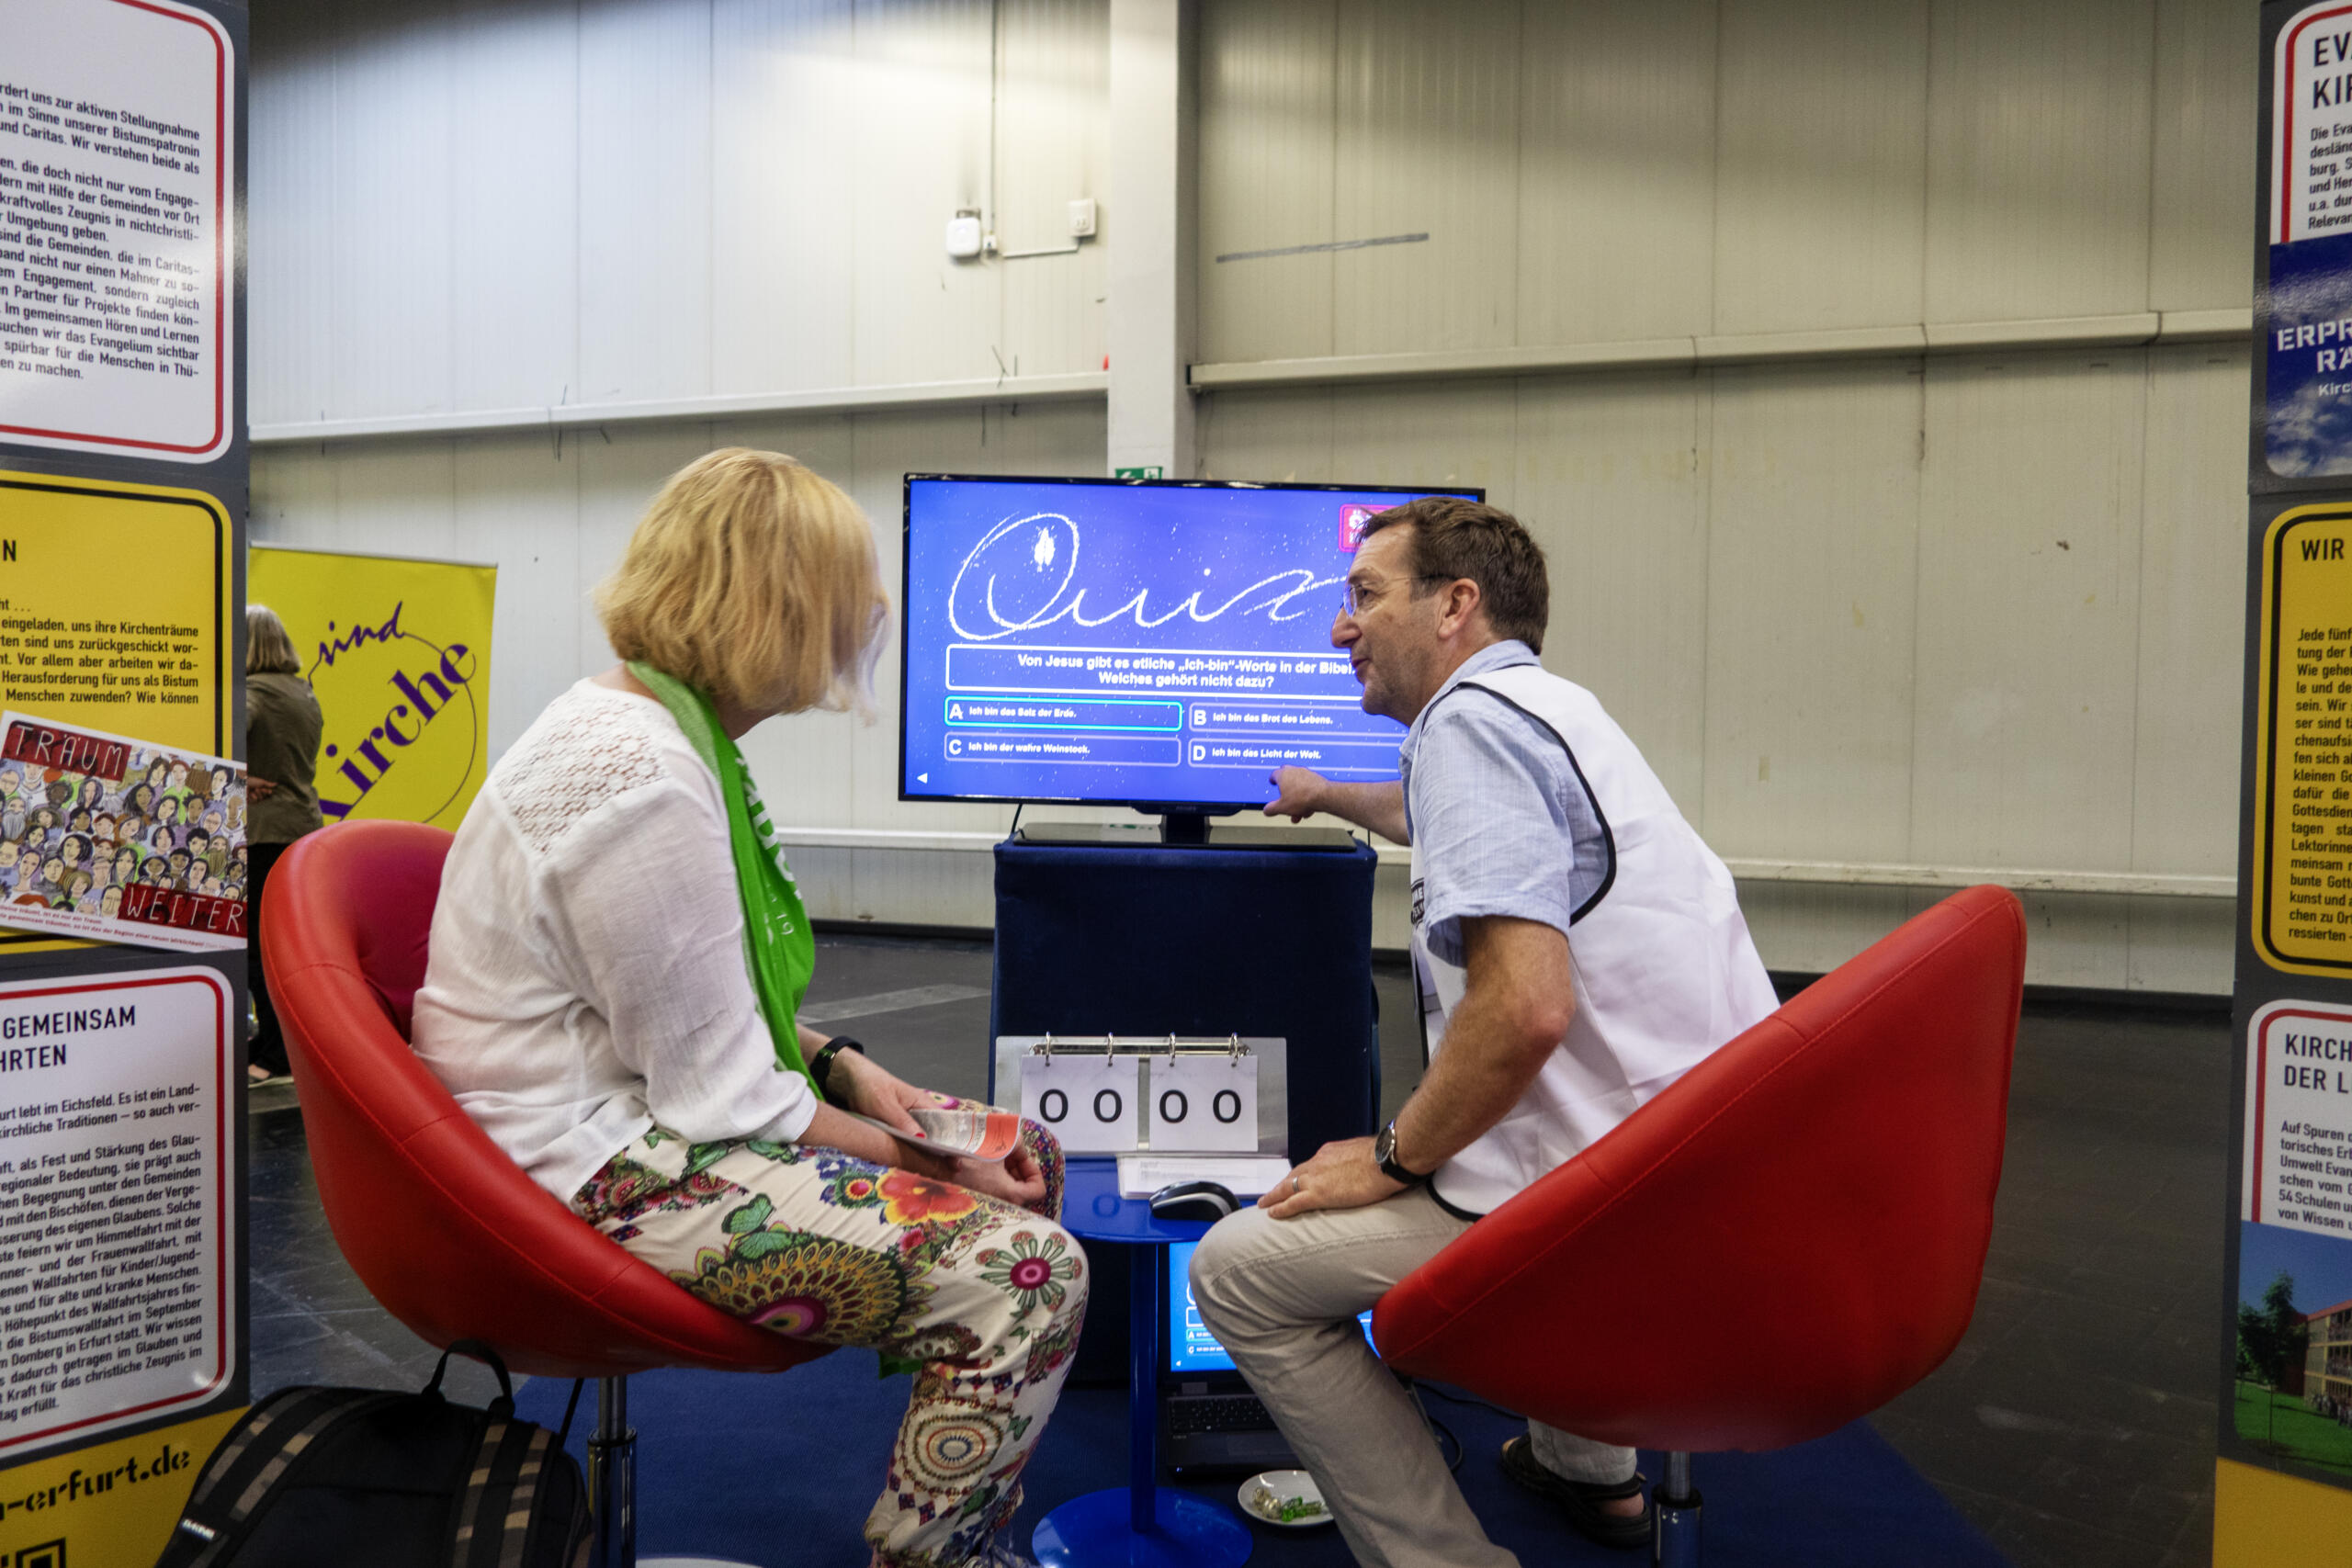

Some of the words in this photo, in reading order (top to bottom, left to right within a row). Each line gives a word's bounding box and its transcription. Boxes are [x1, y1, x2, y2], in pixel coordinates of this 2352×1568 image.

[2314, 31, 2352, 67] EV
[31, 92, 51, 105] uns
[55, 97, 73, 109] zur
[76, 101, 117, 120] aktiven
[120, 110, 199, 140] Stellungnahme
[8, 105, 22, 116] im
[28, 106, 59, 124] Sinne
[64, 118, 107, 135] unserer
[113, 126, 199, 157] Bistumspatronin
[2311, 128, 2328, 141] Die
[71, 134, 89, 149] Wir
[94, 142, 148, 163] verstehen
[153, 152, 180, 170] beide
[184, 161, 198, 174] als
[2310, 178, 2330, 194] und
[15, 285, 57, 303] Partner
[62, 293, 79, 306] für
[85, 296, 130, 315] Projekte
[136, 305, 168, 321] finden
[5, 301, 19, 315] Im
[23, 308, 102, 328] gemeinsamen
[106, 318, 137, 333] Hören
[141, 326, 160, 337] und
[163, 327, 198, 344] Lernen
[2318, 382, 2352, 397] Kirc
[2301, 538, 2345, 562] WIR
[948, 512, 1347, 641] Quiz
[71, 622, 91, 632] uns
[95, 620, 116, 633] ihre
[119, 621, 198, 637] Kirchenträume
[2298, 628, 2324, 641] Jede
[24, 636, 48, 648] sind
[53, 639, 74, 649] uns
[79, 638, 167, 654] zurückgeschickt
[172, 644, 198, 653] wor-
[2297, 647, 2323, 661] tung
[2326, 646, 2346, 658] der
[1018, 654, 1042, 667] Von
[1046, 655, 1083, 668] Jesus
[1087, 656, 1112, 671] gibt
[1114, 659, 1129, 669] es
[1133, 657, 1175, 671] etliche
[1179, 658, 1276, 672] „Ich-bin“-Worte
[1280, 660, 1291, 673] in
[1295, 660, 1316, 673] der
[1319, 661, 1355, 674] Bibel.
[2297, 663, 2318, 675] Wie
[2, 670, 98, 687] Herausforderung
[102, 672, 118, 684] für
[121, 676, 140, 685] uns
[143, 674, 159, 686] als
[163, 674, 198, 687] Bistum
[1099, 671, 1152, 685] Welches
[1156, 673, 1197, 687] gehört
[1201, 675, 1232, 687] nicht
[1236, 676, 1274, 688] dazu?
[6, 688, 64, 701] Menschen
[70, 690, 130, 702] zuwenden?
[136, 691, 155, 703] Wie
[161, 691, 198, 704] können
[2312, 681, 2333, 694] und
[949, 704, 963, 719] A
[969, 706, 982, 716] Ich
[984, 706, 998, 716] bin
[1001, 707, 1015, 716] das
[1018, 707, 1035, 717] Salz
[1038, 708, 1052, 717] der
[2327, 699, 2346, 711] Wir
[1194, 710, 1206, 725] B
[1213, 713, 1226, 722] Ich
[1228, 713, 1241, 722] bin
[1244, 713, 1260, 722] das
[1261, 714, 1280, 723] Brot
[1283, 715, 1297, 724] des
[2317, 716, 2341, 728] sind
[15, 724, 122, 776] TRÄUM
[949, 739, 961, 754] C
[968, 742, 981, 751] Ich
[984, 742, 997, 751] bin
[1000, 743, 1013, 752] der
[1016, 743, 1041, 752] wahre
[1193, 746, 1205, 761] D
[1212, 748, 1225, 757] Ich
[1227, 748, 1240, 757] bin
[1243, 749, 1258, 758] das
[1261, 749, 1282, 759] Licht
[1284, 750, 1298, 759] der
[2315, 751, 2339, 764] sich
[2293, 769, 2335, 782] kleinen
[2293, 786, 2324, 799] dafür
[2332, 787, 2349, 800] die
[2291, 821, 2324, 837] tagen
[2290, 859, 2343, 870] meinsam
[2290, 873, 2321, 886] bunte
[2290, 890, 2322, 904] kunst
[2324, 894, 2346, 906] und
[126, 886, 243, 933] WEITER
[2290, 908, 2316, 921] chen
[2320, 913, 2333, 922] zu
[2289, 927, 2346, 942] ressierten
[3, 1005, 136, 1040] GEMEINSAM
[2285, 1033, 2352, 1062] KIRCH
[2284, 1065, 2326, 1091] DER
[18, 1104, 40, 1118] lebt
[44, 1102, 58, 1114] im
[119, 1092, 131, 1104] Es
[134, 1090, 147, 1102] ist
[150, 1088, 165, 1100] ein
[169, 1083, 199, 1098] Land-
[2280, 1121, 2301, 1134] Auf
[2303, 1123, 2344, 1141] Spuren
[19, 1157, 37, 1170] als
[41, 1153, 65, 1167] Fest
[70, 1148, 90, 1163] und
[95, 1143, 144, 1159] Stärkung
[149, 1138, 167, 1150] des
[171, 1134, 200, 1146] Glau-
[2280, 1138, 2333, 1156] torisches
[2280, 1155, 2323, 1172] Umwelt
[2279, 1174, 2312, 1188] schen
[2318, 1181, 2342, 1192] vom
[2278, 1189, 2292, 1201] 54
[2295, 1191, 2340, 1211] Schulen
[2278, 1209, 2298, 1220] von
[2302, 1210, 2344, 1228] Wissen
[32, 1270, 97, 1291] Wallfahrten
[101, 1266, 117, 1277] für
[120, 1248, 200, 1273] Kinder/Jugend-
[11, 1346, 62, 1366] Domberg
[65, 1342, 75, 1353] in
[79, 1333, 111, 1350] Erfurt
[145, 1322, 162, 1335] Wir
[165, 1314, 201, 1330] wissen
